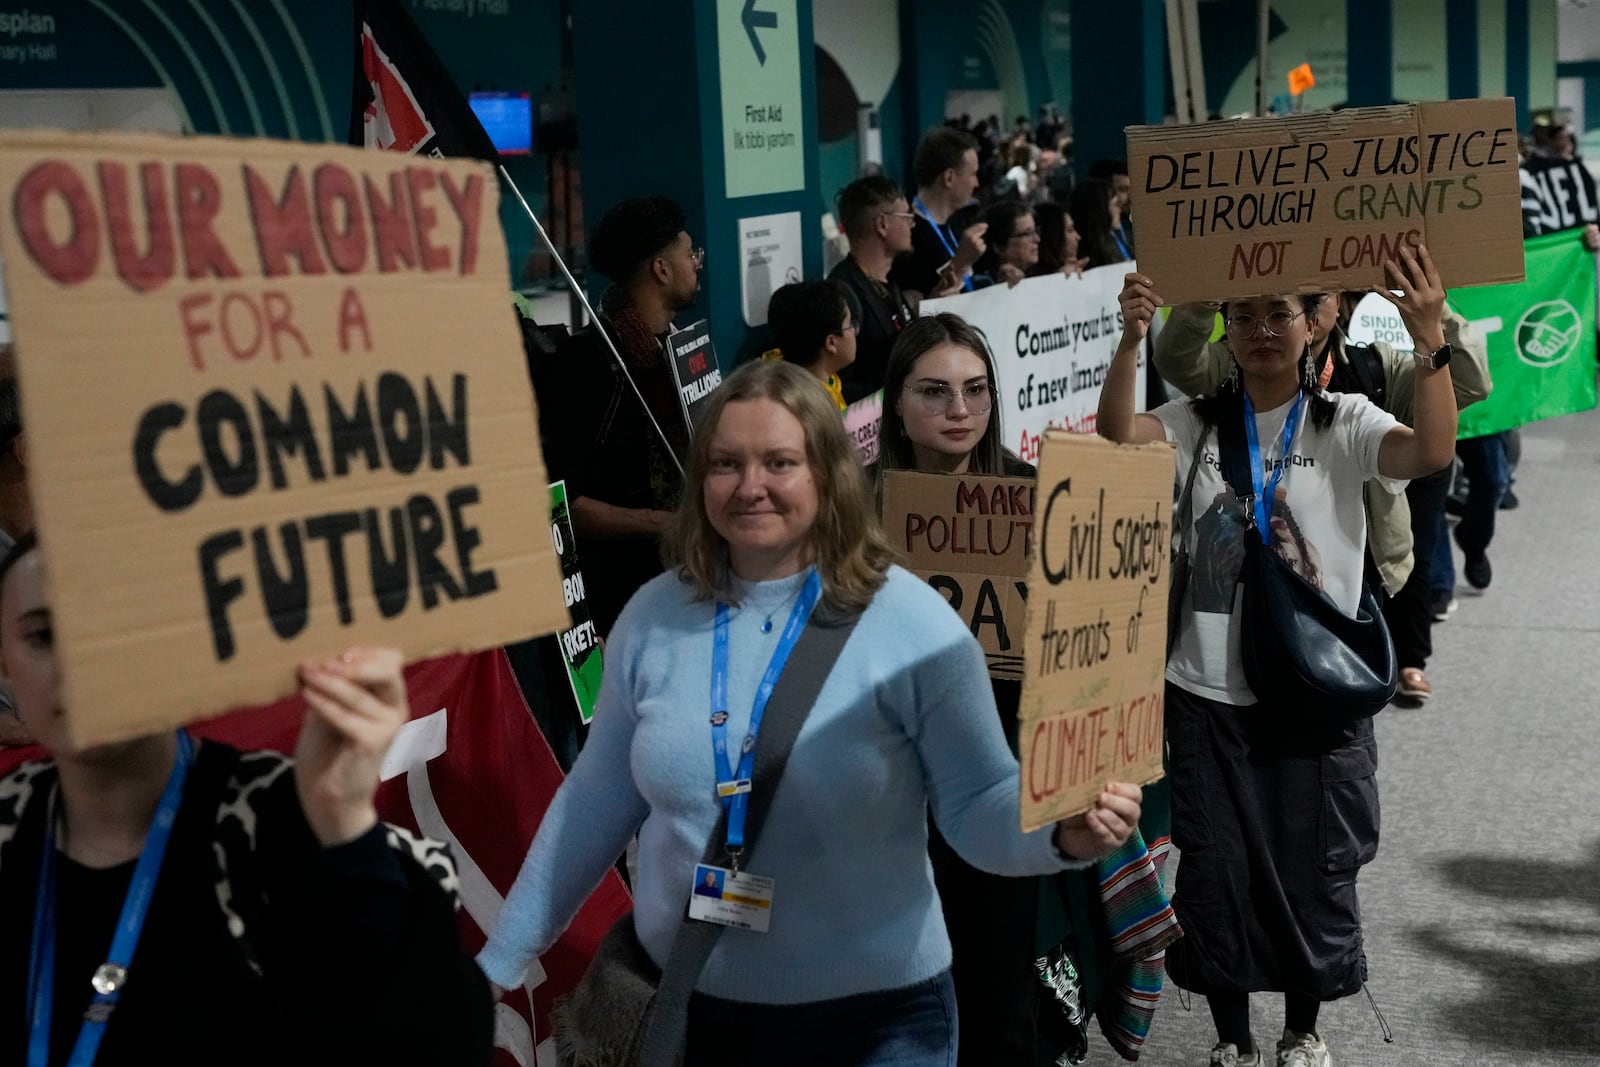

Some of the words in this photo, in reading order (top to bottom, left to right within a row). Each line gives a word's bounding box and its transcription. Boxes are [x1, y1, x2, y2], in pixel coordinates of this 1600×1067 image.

[745, 105, 766, 123] First
[768, 105, 782, 122] Aid
[1146, 143, 1330, 193] DELIVER
[1343, 128, 1512, 177] JUSTICE
[16, 159, 241, 291] OUR
[243, 162, 484, 277] MONEY
[1166, 189, 1315, 239] THROUGH
[1333, 173, 1483, 221] GRANTS
[1228, 240, 1292, 281] NOT
[178, 288, 311, 371] FOR
[337, 287, 373, 352] A
[1374, 329, 1406, 344] POR
[682, 368, 722, 406] TRILLIONS
[1018, 373, 1034, 411] of
[1038, 376, 1067, 405] new
[134, 371, 470, 513] COMMON
[957, 480, 1035, 517] MAK
[552, 522, 564, 555] O
[1041, 477, 1104, 586] Civil
[196, 484, 497, 661] FUTURE
[1039, 600, 1071, 678] the
[1069, 608, 1111, 671] roots
[1126, 585, 1149, 654] of
[1029, 706, 1110, 804] CLIMATE
[1112, 693, 1163, 775] ACTION
